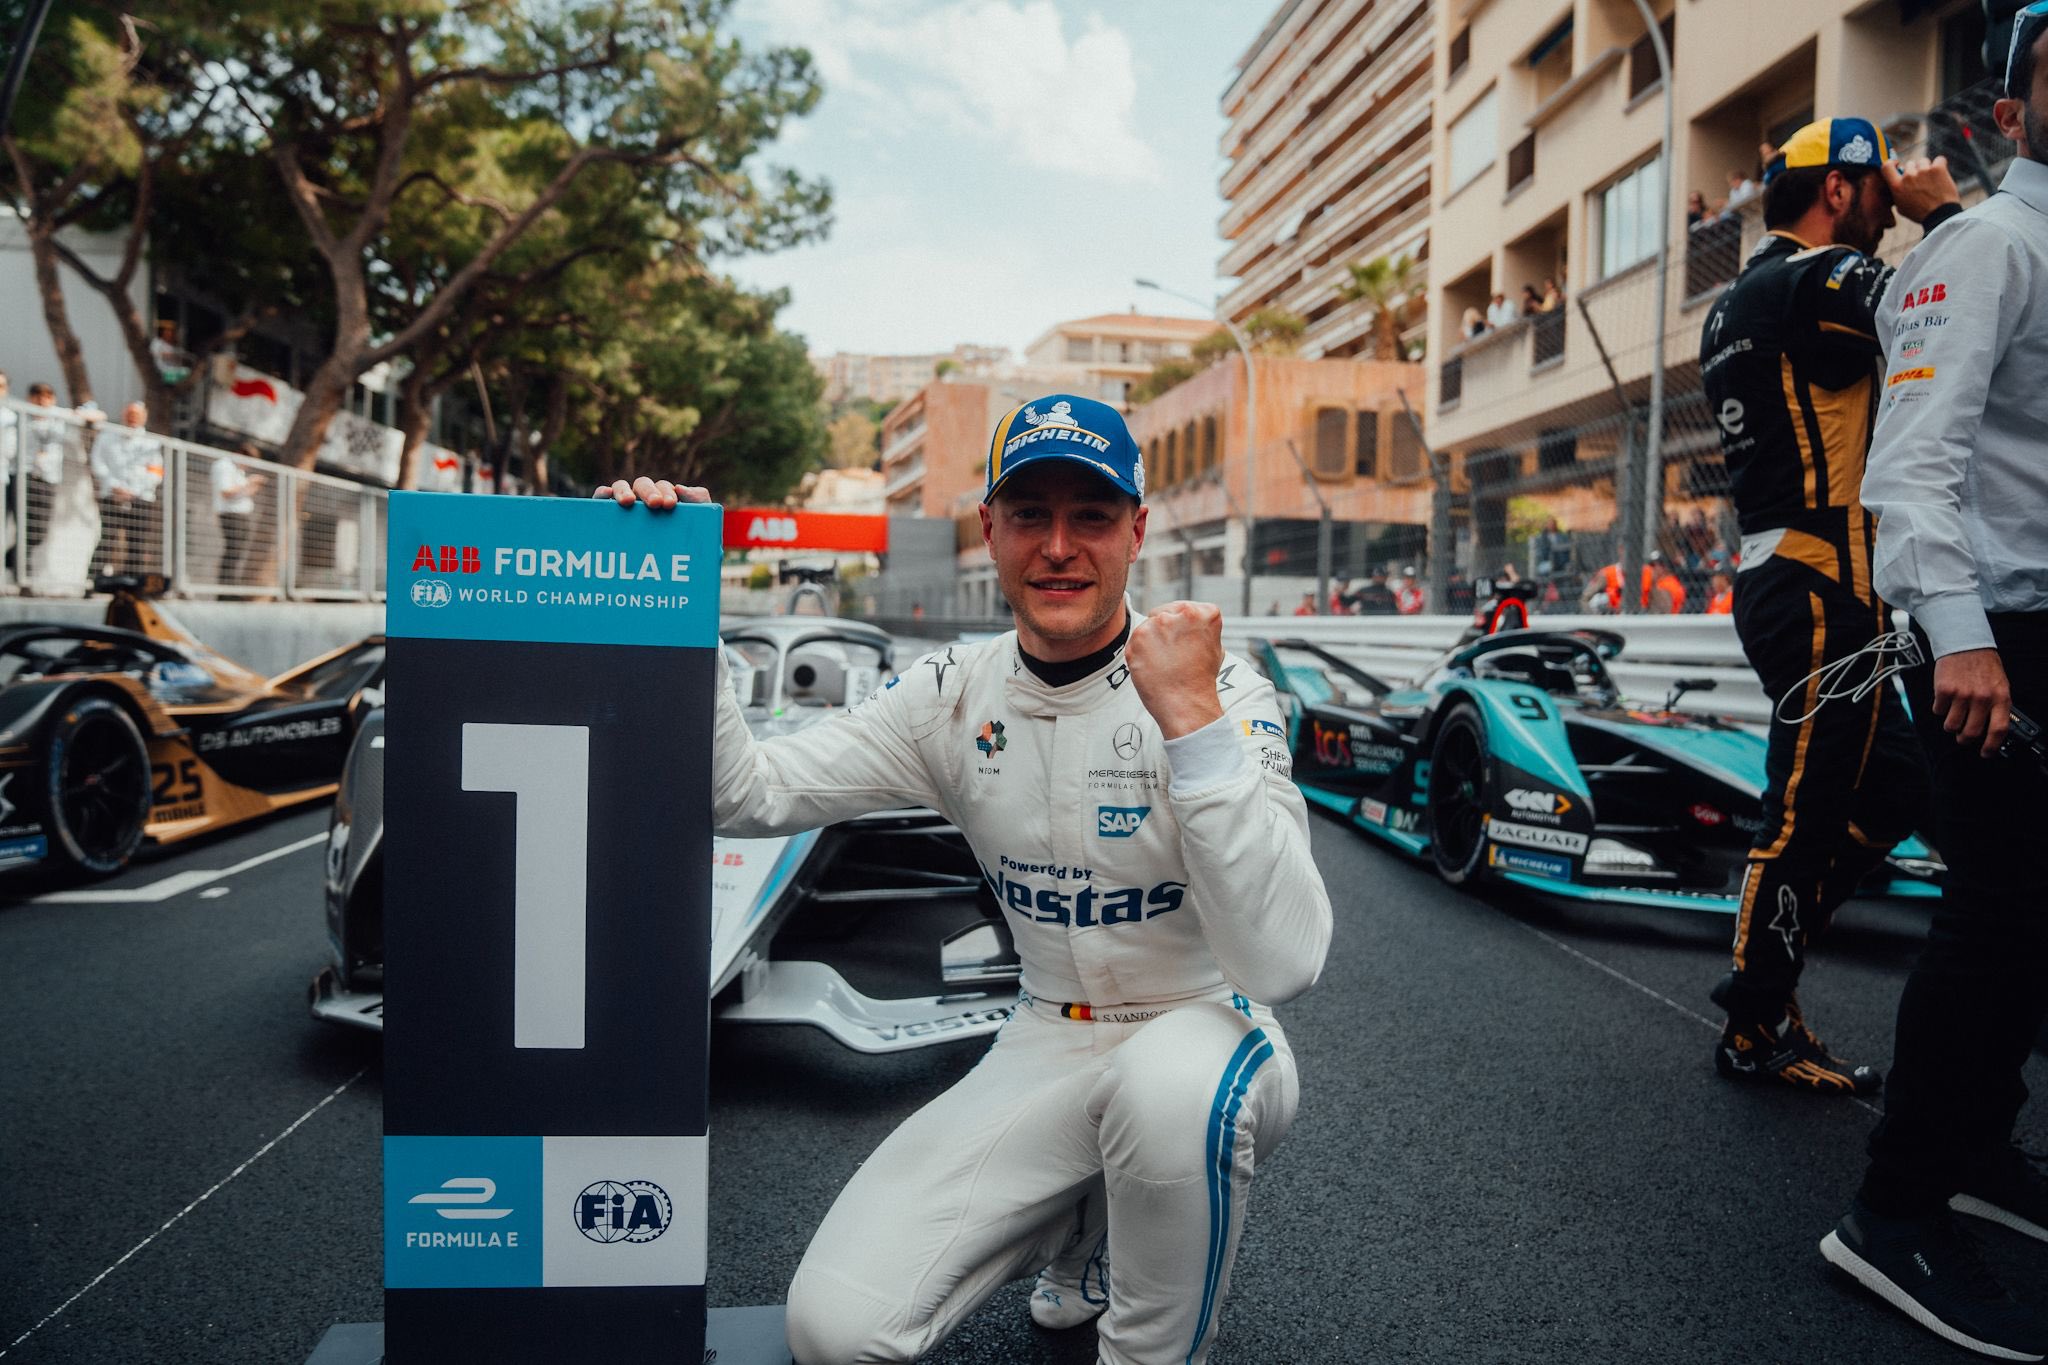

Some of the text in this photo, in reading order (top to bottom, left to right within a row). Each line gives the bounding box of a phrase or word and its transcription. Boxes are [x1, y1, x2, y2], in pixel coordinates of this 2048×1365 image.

[1902, 283, 1947, 313] ABB
[1003, 428, 1110, 459] MICHELIN
[747, 517, 798, 542] ABB
[412, 544, 690, 582] ABB FORMULA E
[458, 588, 528, 603] WORLD
[536, 591, 690, 609] CHAMPIONSHIP
[1511, 694, 1548, 720] 9
[230, 716, 341, 747] AUTOMOBILES
[151, 757, 204, 804] 25
[1099, 811, 1141, 833] SAP
[1511, 808, 1561, 825] AUTOMOTIVE
[1495, 825, 1580, 848] JAGUAR
[1000, 855, 1092, 881] Powered by
[1508, 855, 1562, 874] MICHELIN
[461, 722, 589, 1049] 1
[979, 858, 1187, 928] Vestas
[407, 1231, 518, 1248] FORMULA E
[1912, 1252, 1932, 1277] BOSS
